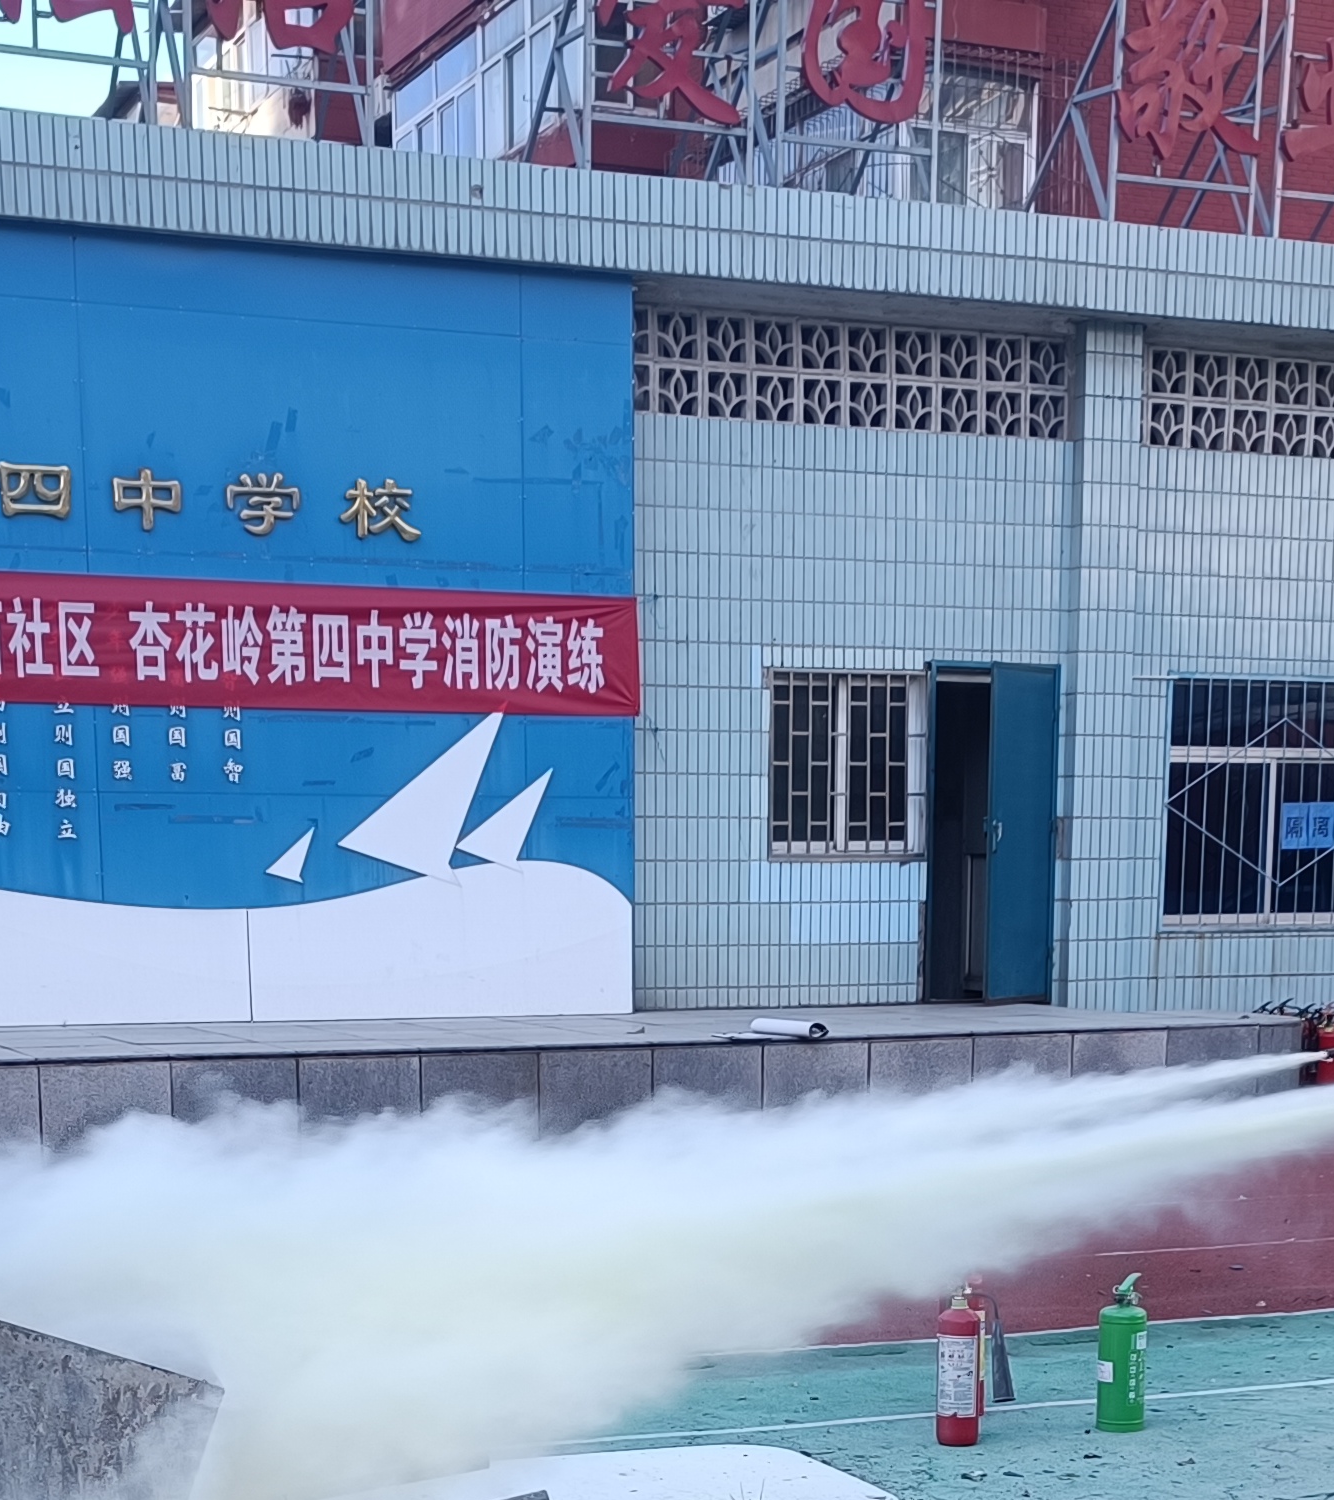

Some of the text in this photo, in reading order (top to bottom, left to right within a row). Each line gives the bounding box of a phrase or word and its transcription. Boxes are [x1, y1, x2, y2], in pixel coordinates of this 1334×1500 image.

[128, 601, 606, 694] 杏花岭第四中学消防演练
